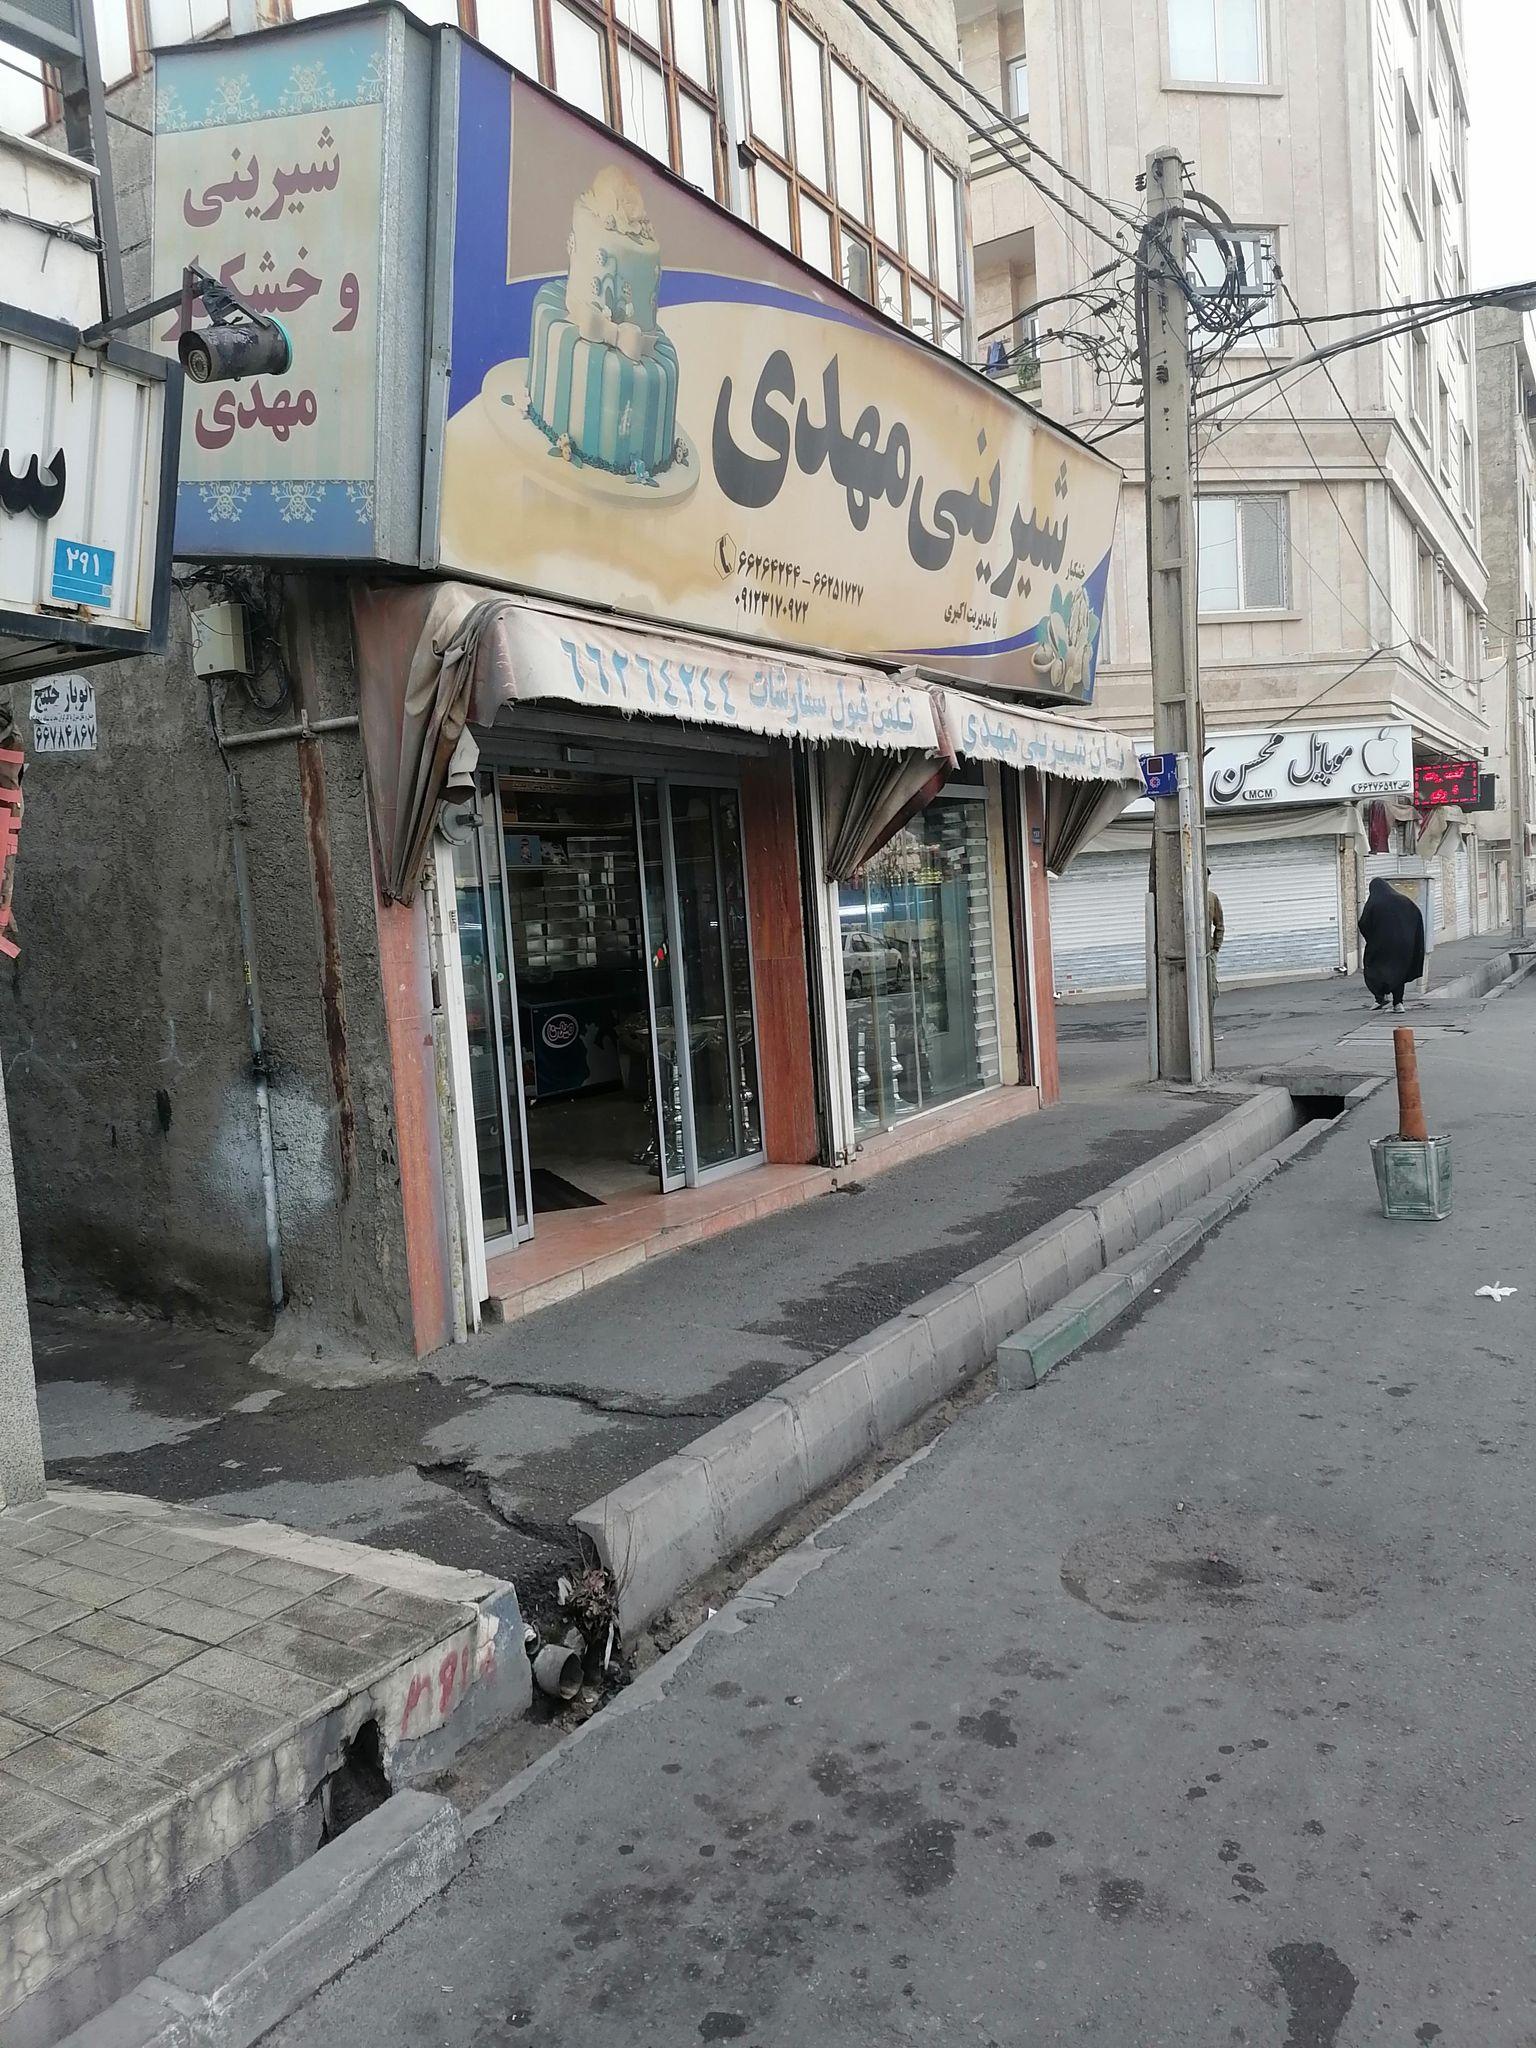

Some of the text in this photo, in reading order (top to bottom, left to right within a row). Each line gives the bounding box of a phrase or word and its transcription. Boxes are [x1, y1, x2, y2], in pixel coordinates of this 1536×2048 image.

[184, 126, 340, 228] شیرینی
[332, 272, 360, 332] و
[194, 379, 318, 450] مهدی
[711, 348, 1069, 599] شیرینی مهدی
[66, 546, 100, 577] ۲۹۱
[966, 608, 991, 631] مدیریت
[962, 713, 1018, 757] مهدی
[1210, 732, 1354, 805] موبایل محسن
[1249, 788, 1273, 799] MCM
